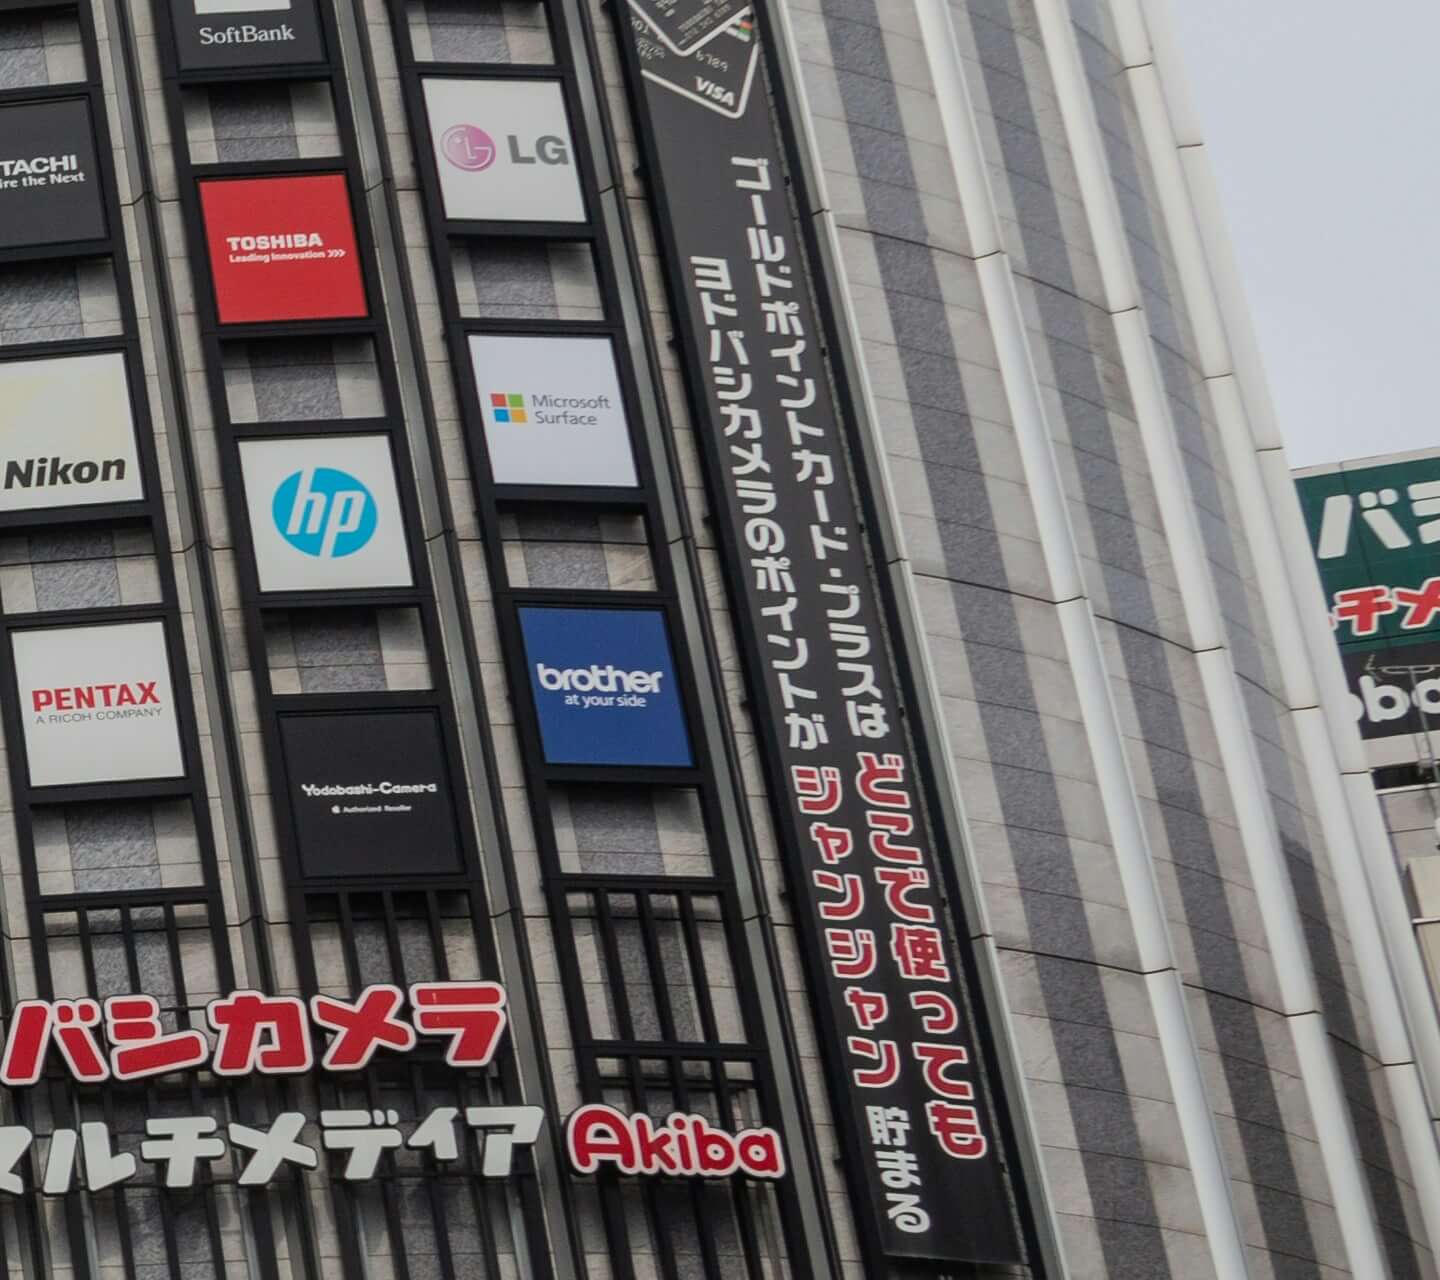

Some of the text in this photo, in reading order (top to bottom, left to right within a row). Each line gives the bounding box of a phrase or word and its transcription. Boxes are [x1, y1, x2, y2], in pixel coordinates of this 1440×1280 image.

[199, 24, 297, 46] SoftBank
[694, 75, 736, 106] VISA
[509, 134, 569, 165] LG
[22, 174, 44, 188] the
[46, 170, 86, 186] Next
[226, 232, 323, 251] TOSHIBA
[229, 249, 326, 264] Leading Innovation
[532, 394, 611, 410] Microsoft
[534, 411, 598, 426] Surface
[2, 457, 126, 490] Nikon
[536, 663, 663, 693] brother
[31, 681, 160, 712] PENTAX
[582, 693, 647, 708] your side
[48, 706, 164, 723] RICOH COMPANY
[301, 781, 437, 797] Yodobashi-Camera
[856, 751, 987, 1160] どこで使っても
[791, 764, 931, 1234] ジャンジャン 貯まる
[566, 1102, 786, 1179] Akiba
